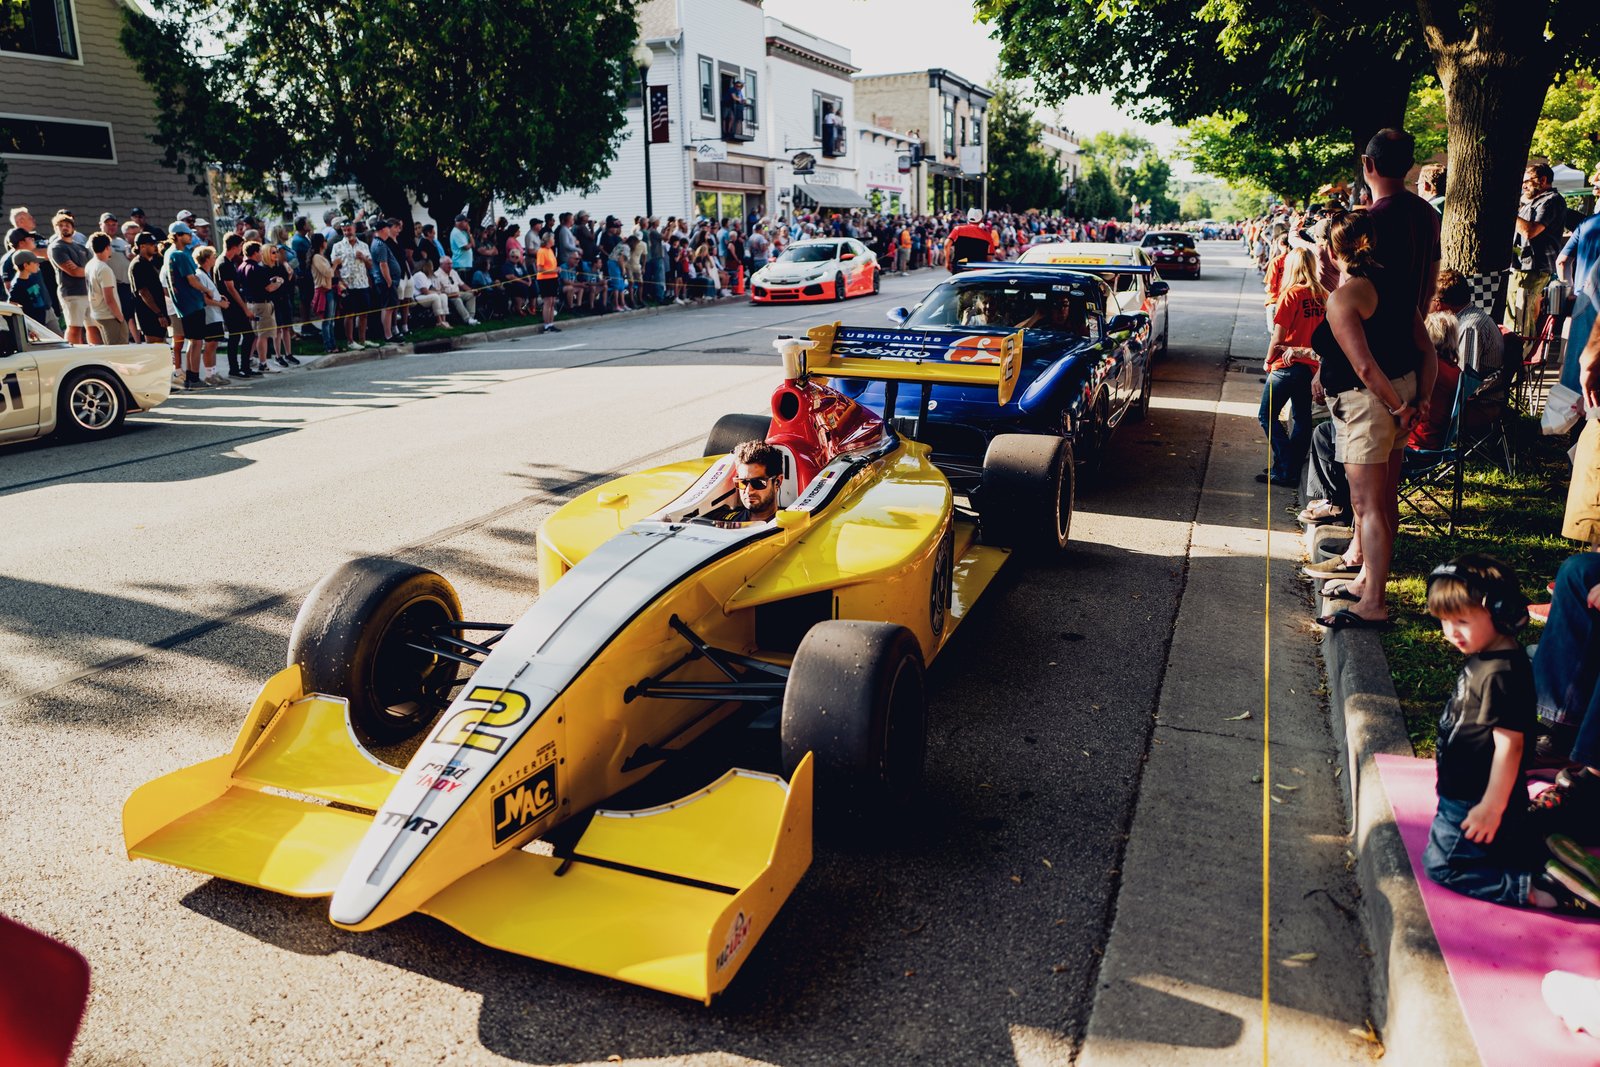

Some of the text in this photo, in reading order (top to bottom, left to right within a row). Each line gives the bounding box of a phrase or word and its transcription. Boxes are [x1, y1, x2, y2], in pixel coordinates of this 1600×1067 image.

[838, 332, 942, 342] LUBRICANTES
[1005, 338, 1014, 381] 2
[431, 685, 531, 755] 2
[415, 774, 462, 792] INDY
[490, 748, 557, 794] BATTERIES
[382, 812, 439, 835] TMR
[496, 780, 555, 830] MAC
